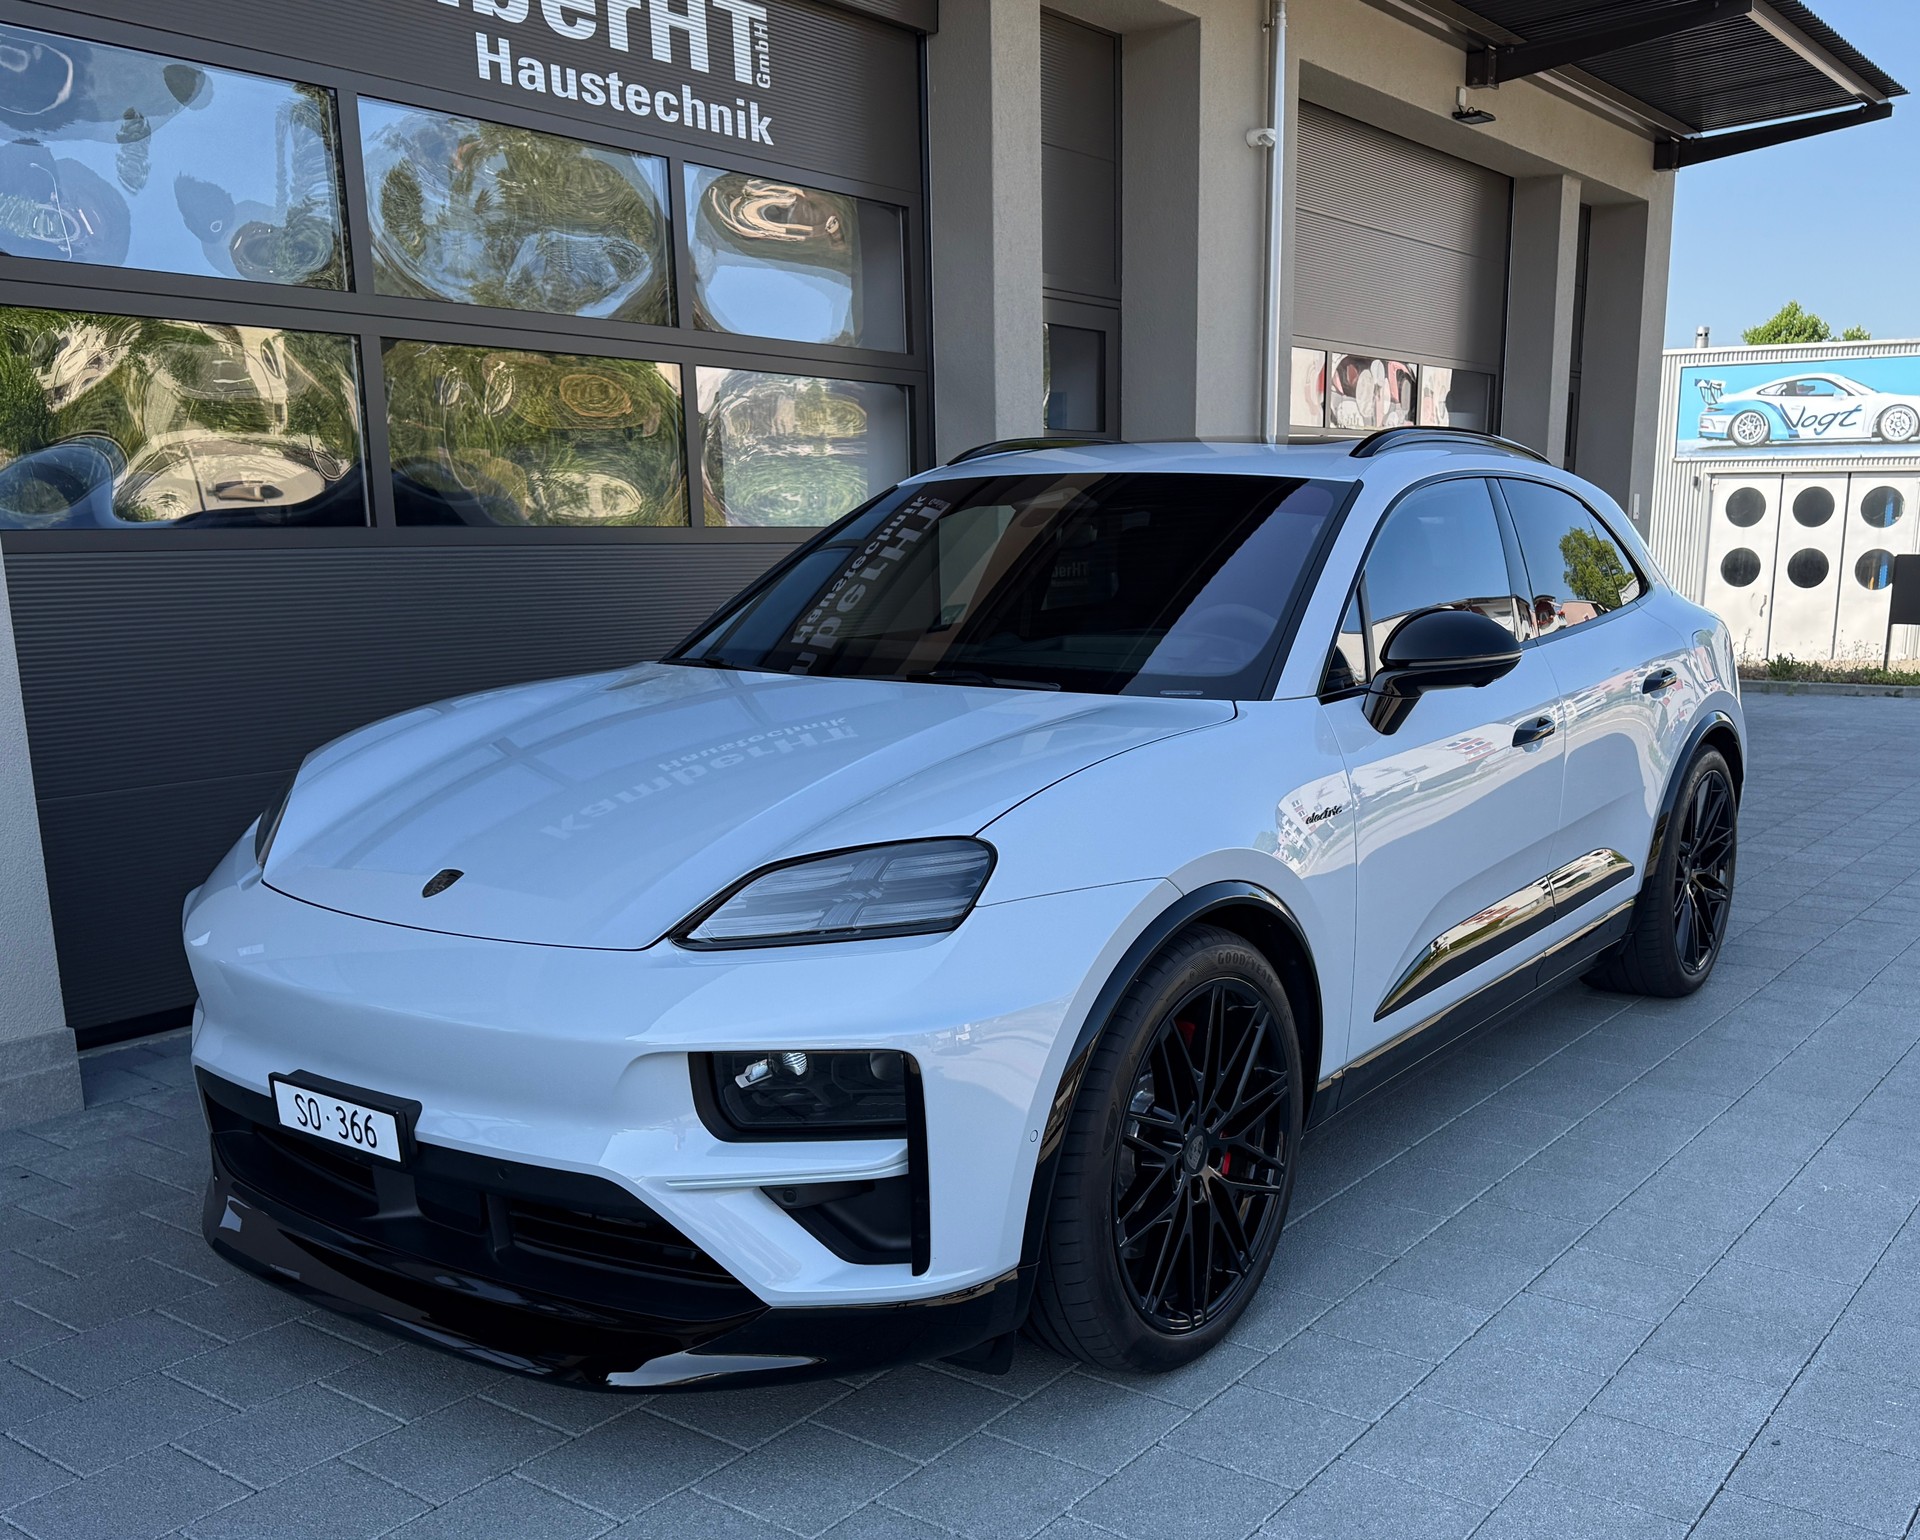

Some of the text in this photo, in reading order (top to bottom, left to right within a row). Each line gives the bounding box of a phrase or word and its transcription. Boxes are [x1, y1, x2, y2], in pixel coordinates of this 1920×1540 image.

[437, 0, 767, 85] erHT
[755, 23, 772, 89] GmbH
[475, 32, 774, 146] Haustechnik
[1779, 403, 1862, 435] Vogt
[1305, 805, 1342, 825] electric
[1217, 952, 1274, 986] GOODYEAR
